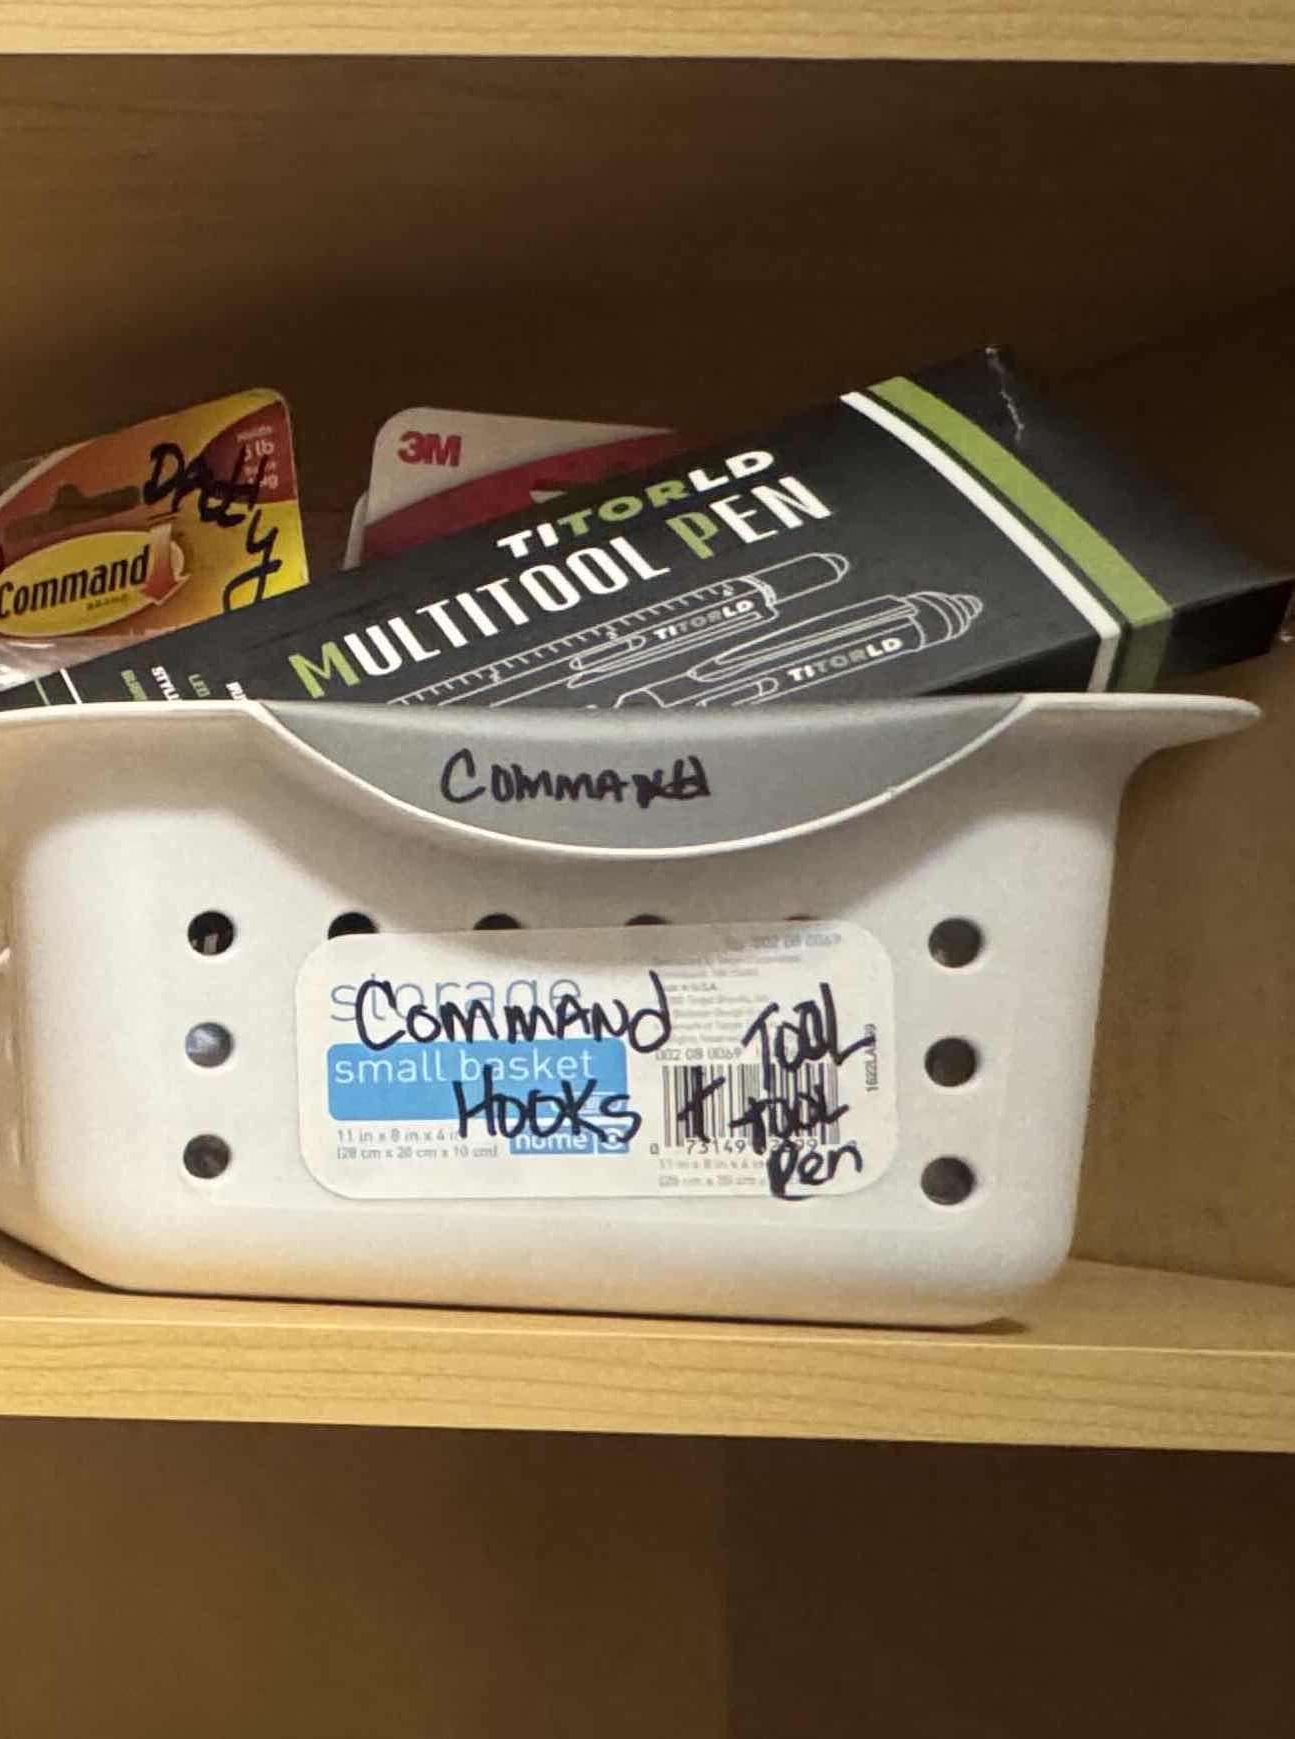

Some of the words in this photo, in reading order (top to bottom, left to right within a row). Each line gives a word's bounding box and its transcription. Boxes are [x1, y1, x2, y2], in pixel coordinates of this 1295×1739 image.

[397, 431, 462, 467] 3M
[496, 450, 776, 558] TITORLD
[288, 535, 672, 699] MULTITOOL
[666, 476, 833, 560] PEN
[652, 599, 755, 641] TITORLD
[786, 637, 904, 682] TITORLD
[334, 1049, 446, 1085] small
[460, 1049, 594, 1080] basket
